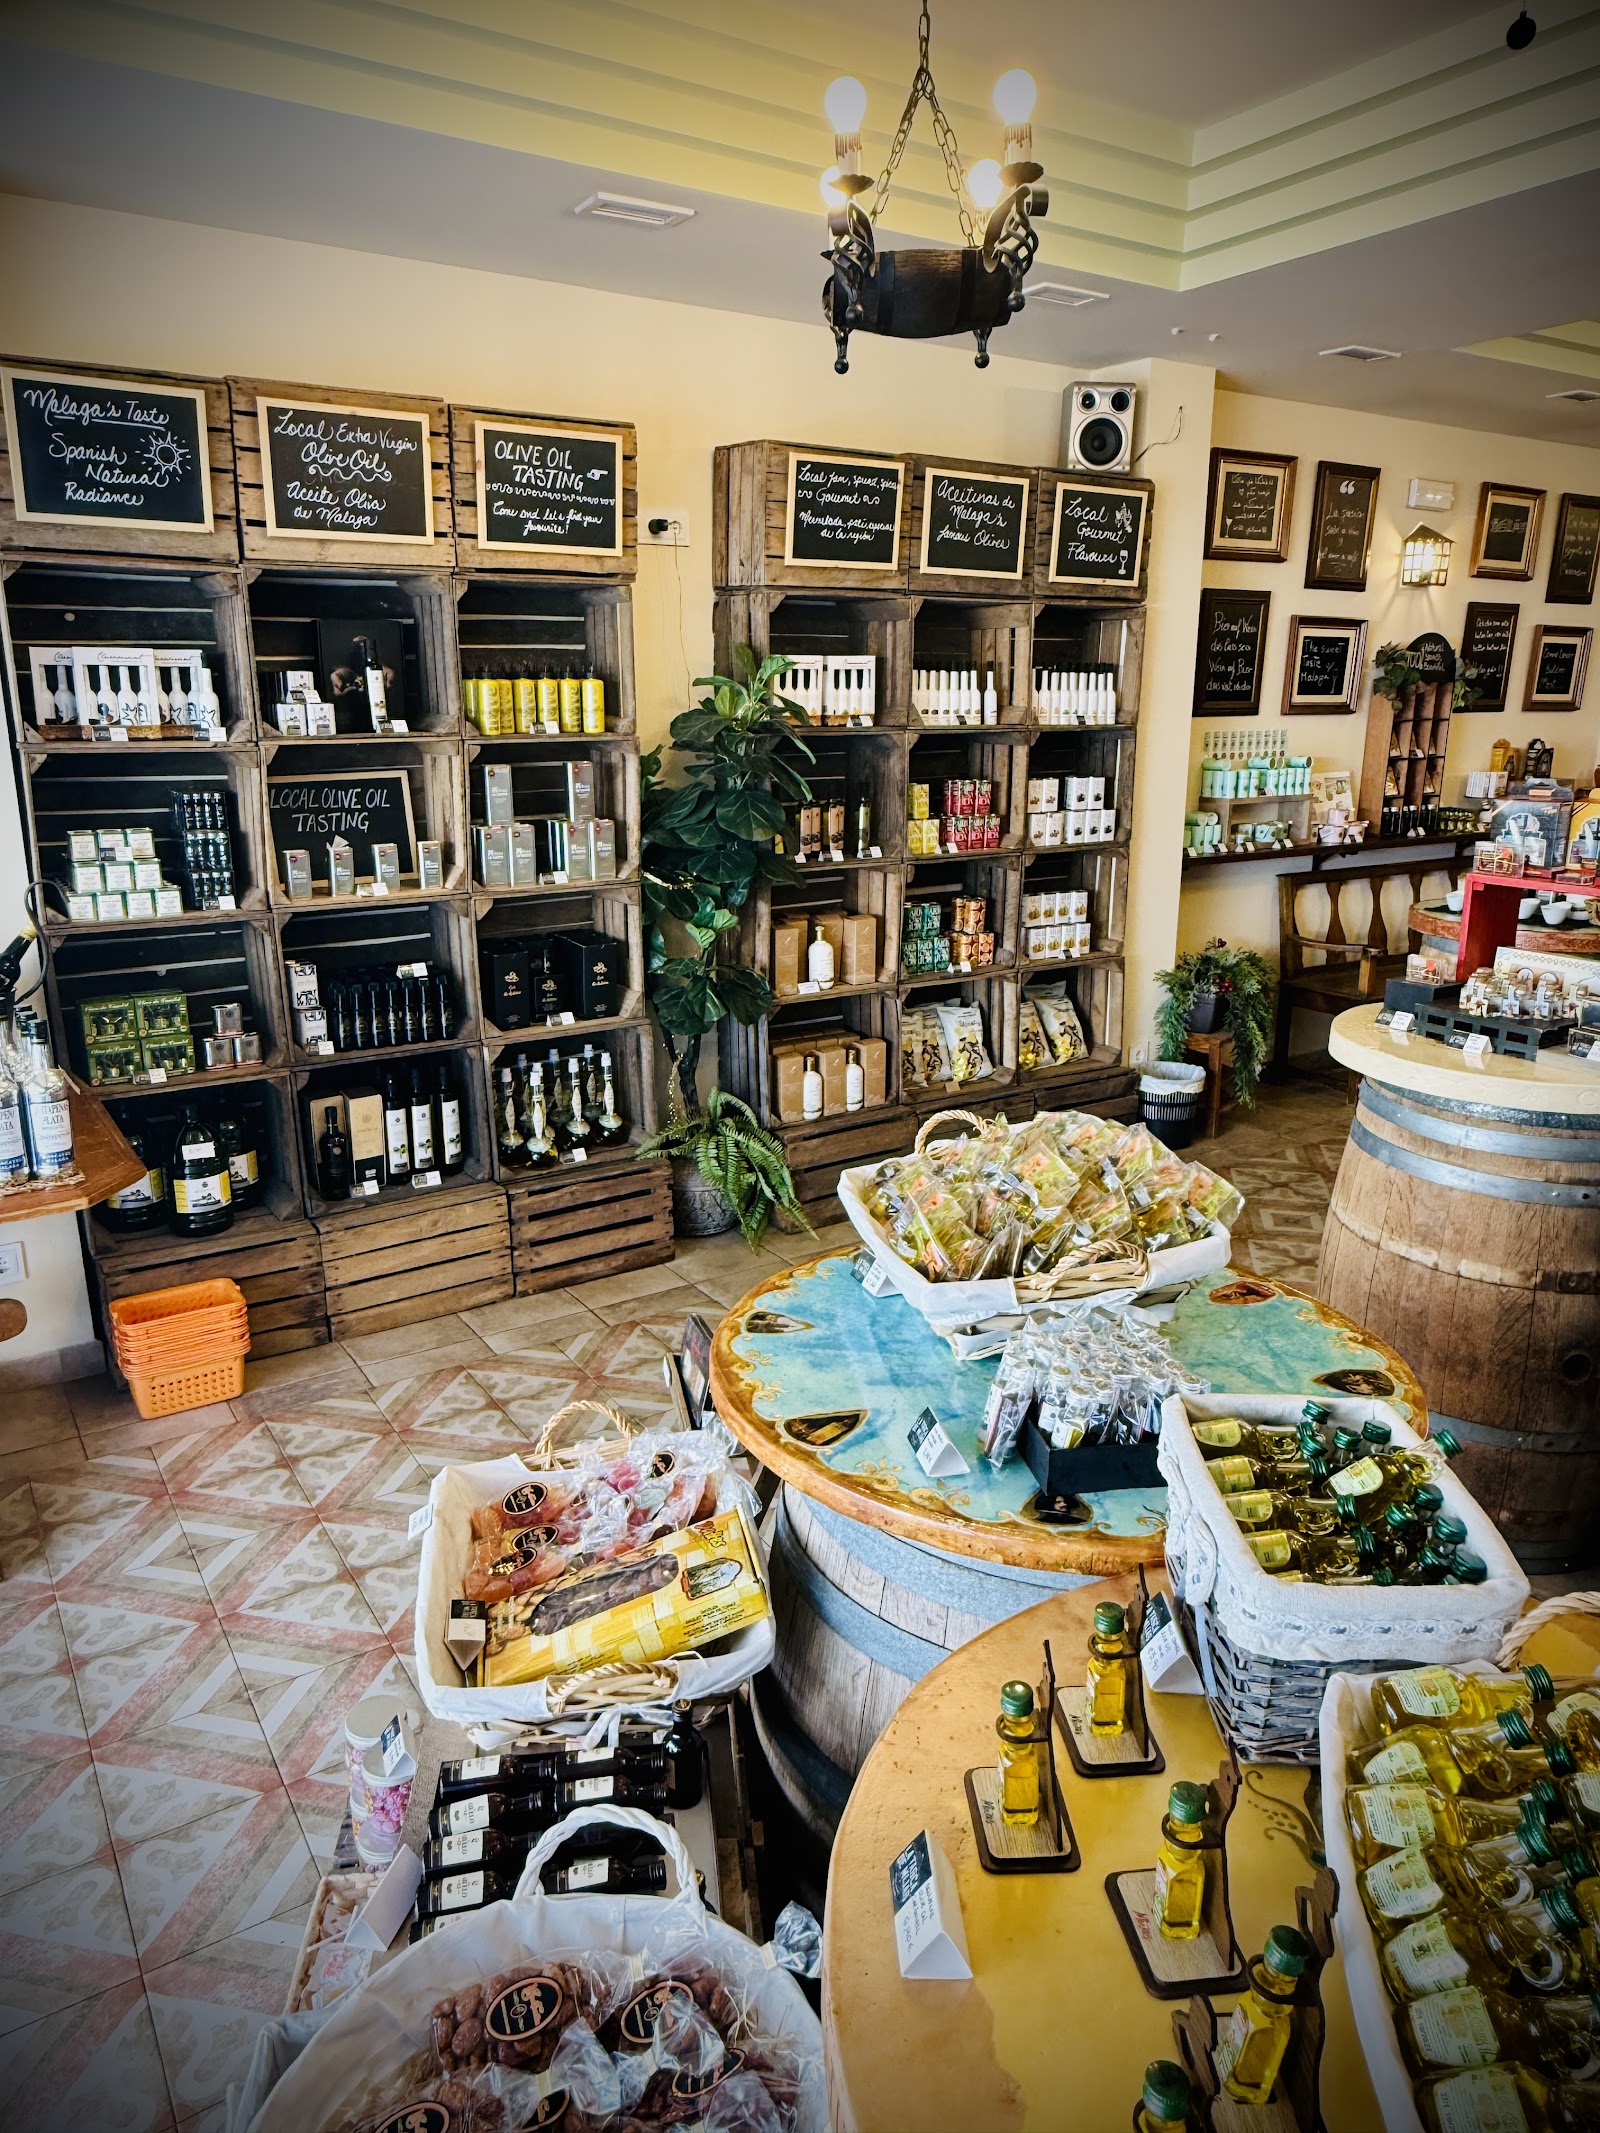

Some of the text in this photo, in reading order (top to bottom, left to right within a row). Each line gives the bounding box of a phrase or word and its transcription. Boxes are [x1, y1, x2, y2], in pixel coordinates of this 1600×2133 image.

[24, 389, 170, 426] Malaga's Taste
[274, 410, 418, 455] Local Extra Virgin
[49, 433, 127, 465] Spanish
[301, 442, 387, 472] Olive Oil
[494, 440, 573, 469] OLIVE OIL
[85, 464, 170, 487] Natural
[512, 465, 584, 493] TASTING
[798, 464, 827, 483] Local
[65, 482, 144, 505] Radiance
[287, 481, 387, 511] Aceite Oliva
[816, 487, 861, 506] Gourmet
[1002, 495, 1016, 509] de
[294, 507, 378, 529] de Malaga
[493, 501, 518, 517] Come
[519, 508, 540, 520] and
[949, 504, 1007, 529] Malaga's
[1065, 497, 1109, 523] Local
[973, 529, 1011, 549] Olives
[1076, 521, 1127, 544] Gourmet
[1068, 542, 1118, 563] Flavours
[270, 787, 391, 809] LOCAL OLIVE OIL
[292, 811, 370, 834] TASTING
[897, 1851, 906, 1871] DE
[905, 1842, 915, 1861] LA
